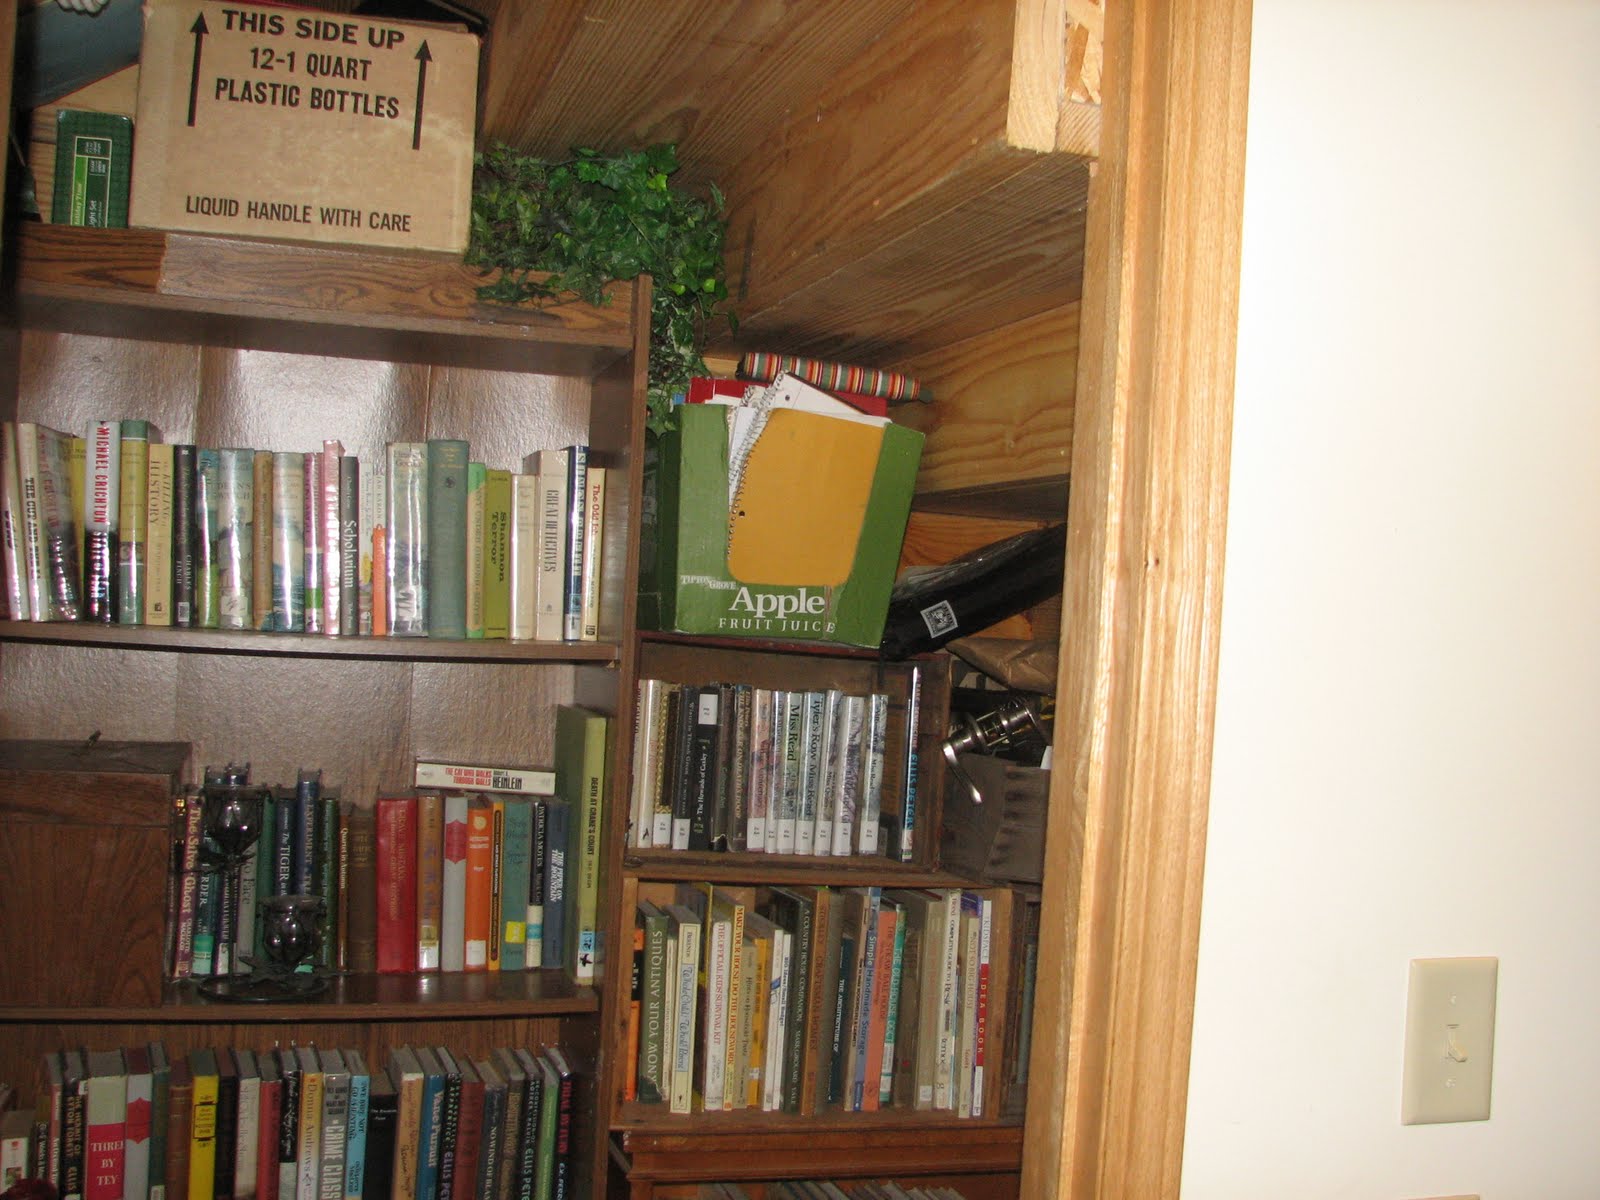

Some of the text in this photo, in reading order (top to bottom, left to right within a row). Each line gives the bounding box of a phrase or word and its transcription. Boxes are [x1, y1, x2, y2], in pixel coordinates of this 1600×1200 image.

[222, 9, 405, 50] THIS SIDE UP
[249, 47, 372, 82] 12-1 QUART
[215, 78, 400, 119] PLASTIC BOTTLES
[185, 195, 411, 232] LIQUID HANDLE WITH CARE
[25, 478, 35, 498] THE
[94, 426, 108, 523] MICHAEL CRICHTON
[150, 460, 161, 525] HISTORY
[576, 452, 586, 511] SIMON
[163, 473, 171, 517] KILLING
[591, 484, 600, 521] The Odd
[491, 511, 499, 564] Terror
[499, 511, 507, 583] Shannon
[544, 489, 559, 572] GREAT DETECTIVES
[343, 519, 358, 588] Scholarium
[709, 579, 736, 591] GROVE
[728, 587, 825, 618] Apple
[719, 617, 836, 634] FRUIT JUICE
[687, 702, 695, 724] Winter
[736, 706, 744, 746] KNOCKER
[790, 704, 800, 731] Miss
[686, 733, 694, 755] Thrush
[736, 747, 743, 759] ON
[787, 732, 799, 761] Read
[806, 699, 822, 817] Tyler's Row Miss Read
[493, 776, 522, 790] HEINLEIN
[906, 753, 918, 831] ELLIS PETERS
[537, 805, 545, 839] PATRICIA
[586, 777, 599, 856] DEATH AT CRANE'S COURT
[181, 807, 201, 914] The Silve Ghost
[280, 844, 291, 881] TIGER
[340, 827, 349, 889] Quartet in Autumn
[550, 849, 559, 903] THE MOUNTAIN
[242, 877, 256, 905] Face
[556, 867, 564, 886] PIPER
[556, 888, 563, 900] ON
[717, 922, 726, 938] THE
[801, 915, 809, 951] COUNTRY
[887, 926, 895, 940] THE
[947, 920, 955, 954] COMPLETE
[716, 938, 725, 973] OFFICIAL
[799, 951, 807, 976] HOUSE
[884, 942, 894, 972] STRAW
[966, 936, 977, 1010] NOT SO BIG HOUSE
[727, 907, 744, 1065] MAKE YOUR HOUSE DO THE HOUSEWORK
[744, 976, 753, 993] Hints
[809, 904, 827, 1051] STICKLEY CRAFTSMAN HOMES
[858, 935, 877, 1056] Simple Handmade Storage
[882, 973, 892, 993] BALE
[889, 947, 903, 1018] THE OLD-HOUSE
[977, 919, 990, 1054] KIDSPACE IDEA BOOK
[647, 930, 663, 1083] KNOW YOUR ANTIQUES
[714, 994, 723, 1030] SURVIVAL
[796, 976, 807, 1022] COMPANION
[879, 994, 890, 1020] HOUSE
[742, 1004, 751, 1038] Household
[834, 994, 843, 1041] ARCHITECTURE
[714, 1030, 722, 1046] KIT
[833, 1043, 839, 1053] OF
[791, 1049, 800, 1084] GIROUARD
[305, 1083, 318, 1172] Donna Andrews
[428, 1089, 444, 1168] Vane Pursuit
[446, 1086, 455, 1141] APPRENTICE
[558, 1081, 572, 1152] TRIAL BY FURY
[66, 1126, 75, 1158] FOREST
[324, 1125, 345, 1159] CRIME
[486, 1126, 497, 1177] NO WIND OF
[101, 1158, 116, 1168] BY
[442, 1150, 451, 1179] ELLIS
[524, 1147, 533, 1174] ELLIS
[68, 1167, 77, 1191] ELLIS
[96, 1176, 117, 1186] TEY
